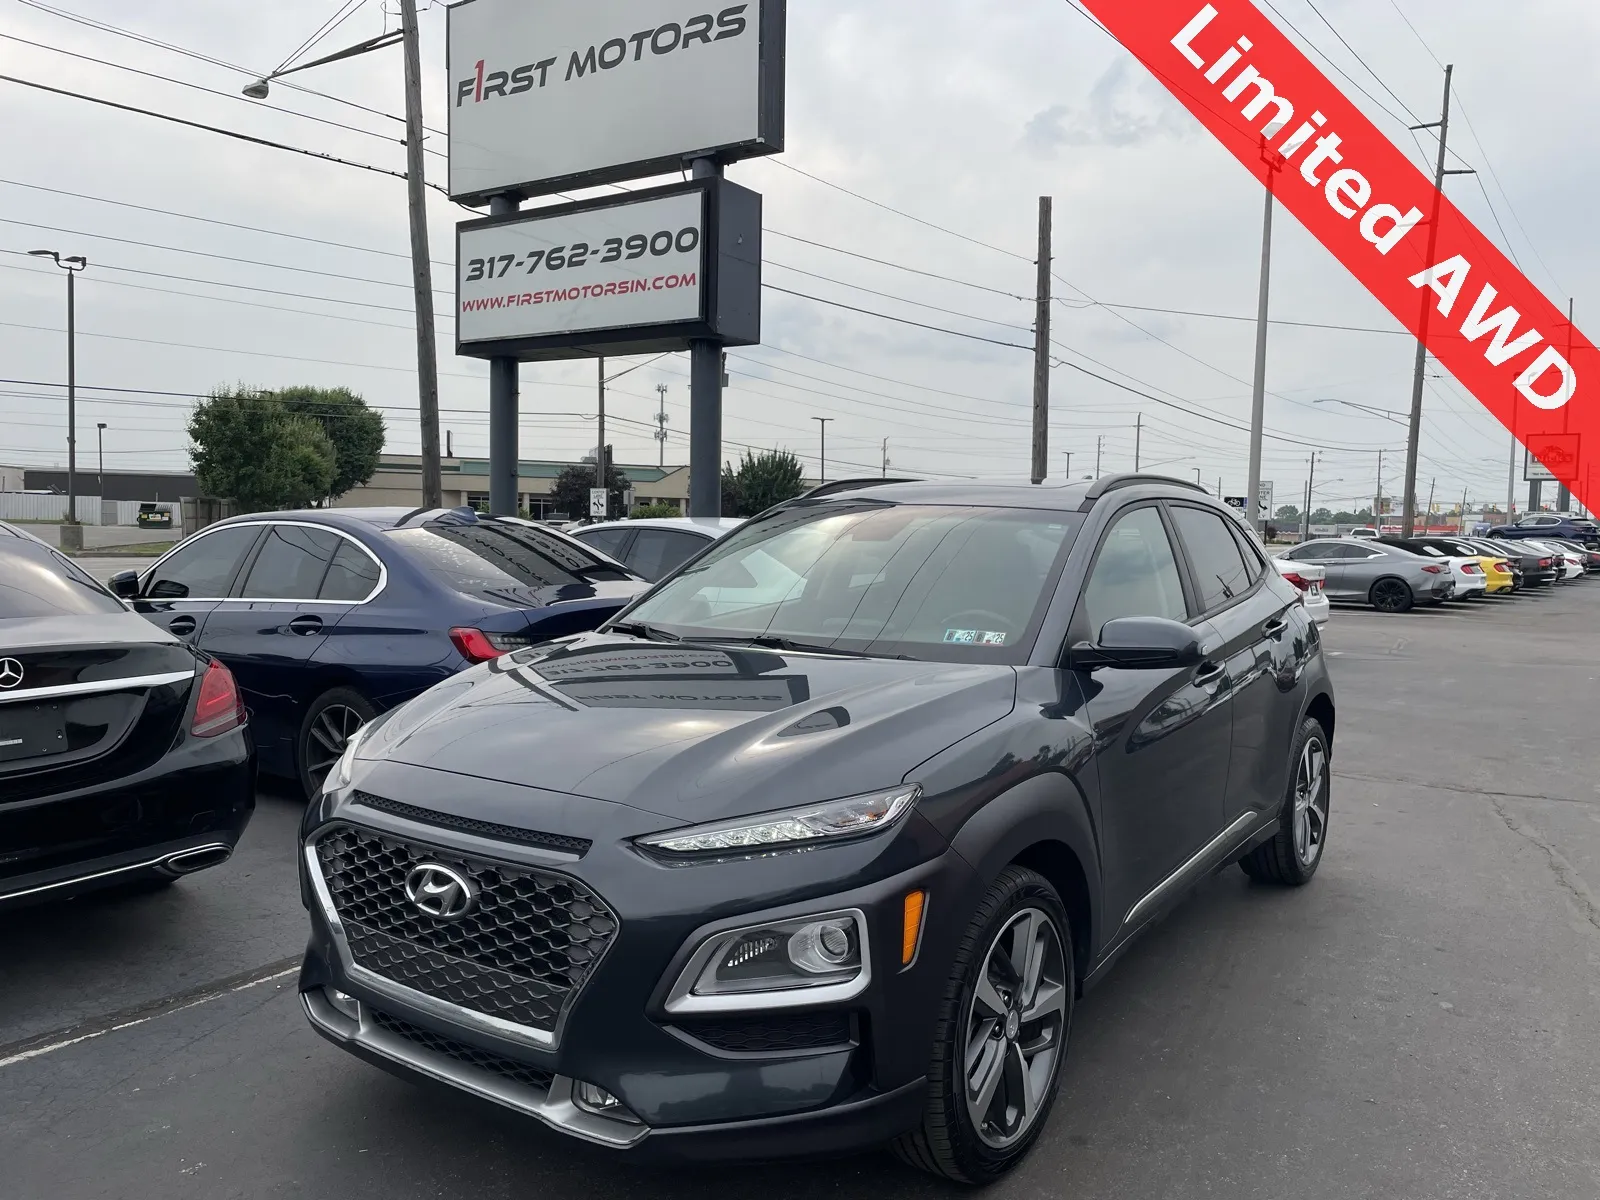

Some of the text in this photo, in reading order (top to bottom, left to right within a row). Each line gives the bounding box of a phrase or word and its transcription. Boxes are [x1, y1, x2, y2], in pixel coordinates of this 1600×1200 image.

[564, 3, 749, 81] MOTORS
[465, 226, 700, 282] 317-762-3900
[462, 272, 697, 312] WWW.FIRSTMOTORSIN.COM
